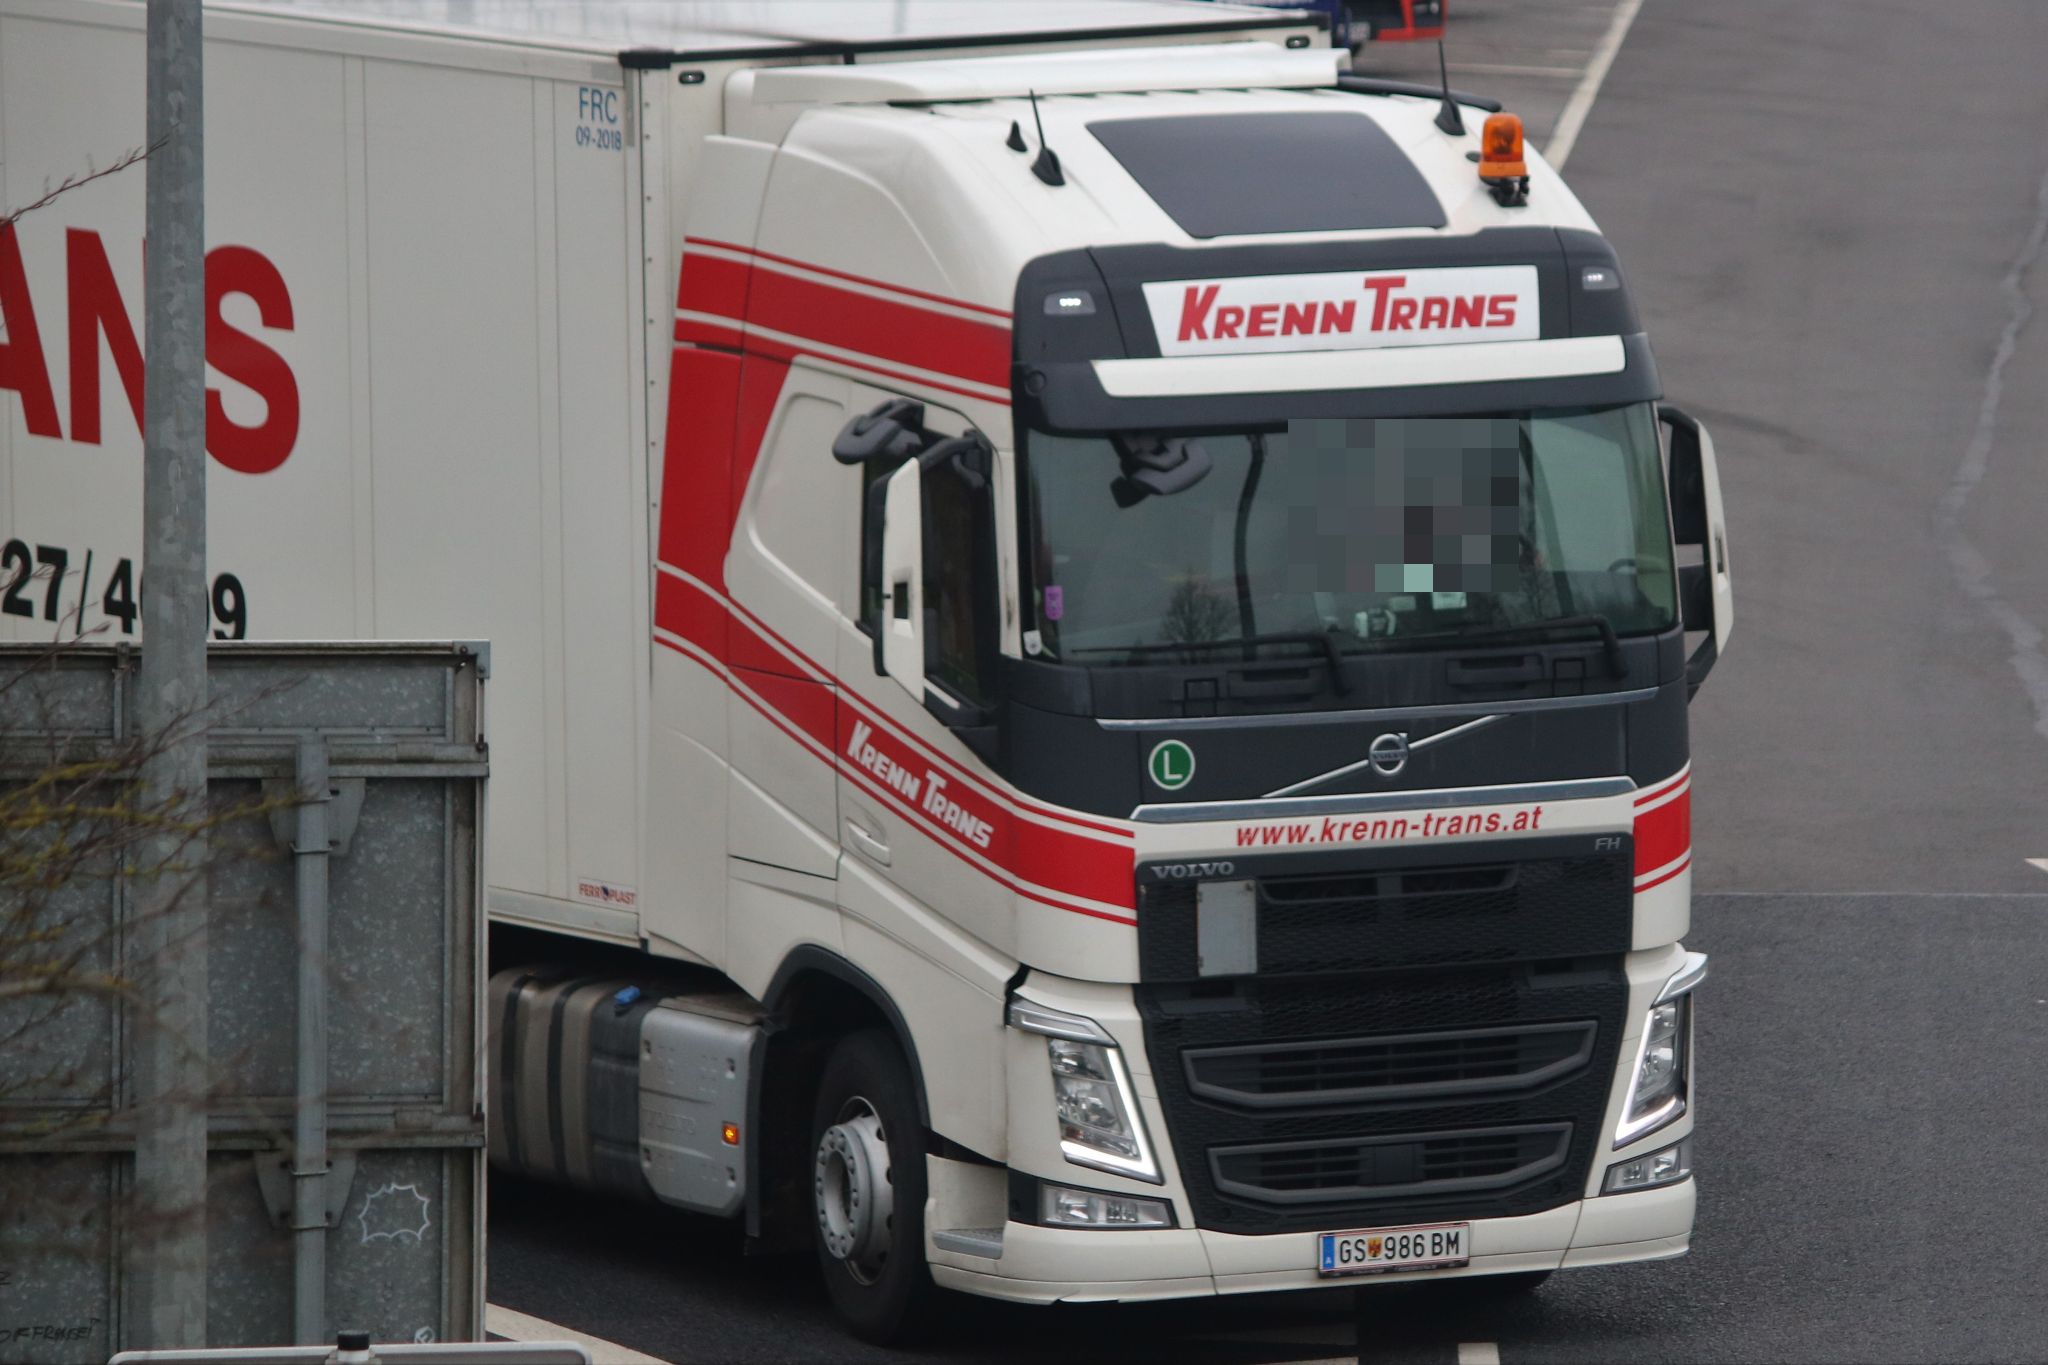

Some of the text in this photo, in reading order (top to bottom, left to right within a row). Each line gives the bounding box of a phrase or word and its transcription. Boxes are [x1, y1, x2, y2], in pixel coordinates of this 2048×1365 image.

[578, 86, 618, 125] FRC
[1176, 275, 1518, 342] KRENN TRANS
[1163, 750, 1184, 780] L
[847, 719, 995, 849] KRENN TRANS
[1236, 806, 1544, 847] www.krenn-trans.at
[1595, 836, 1622, 851] FH
[1151, 861, 1236, 879] VOLVO
[1339, 1239, 1367, 1264] GS
[1384, 1233, 1426, 1260] 986
[1431, 1231, 1461, 1257] BM
